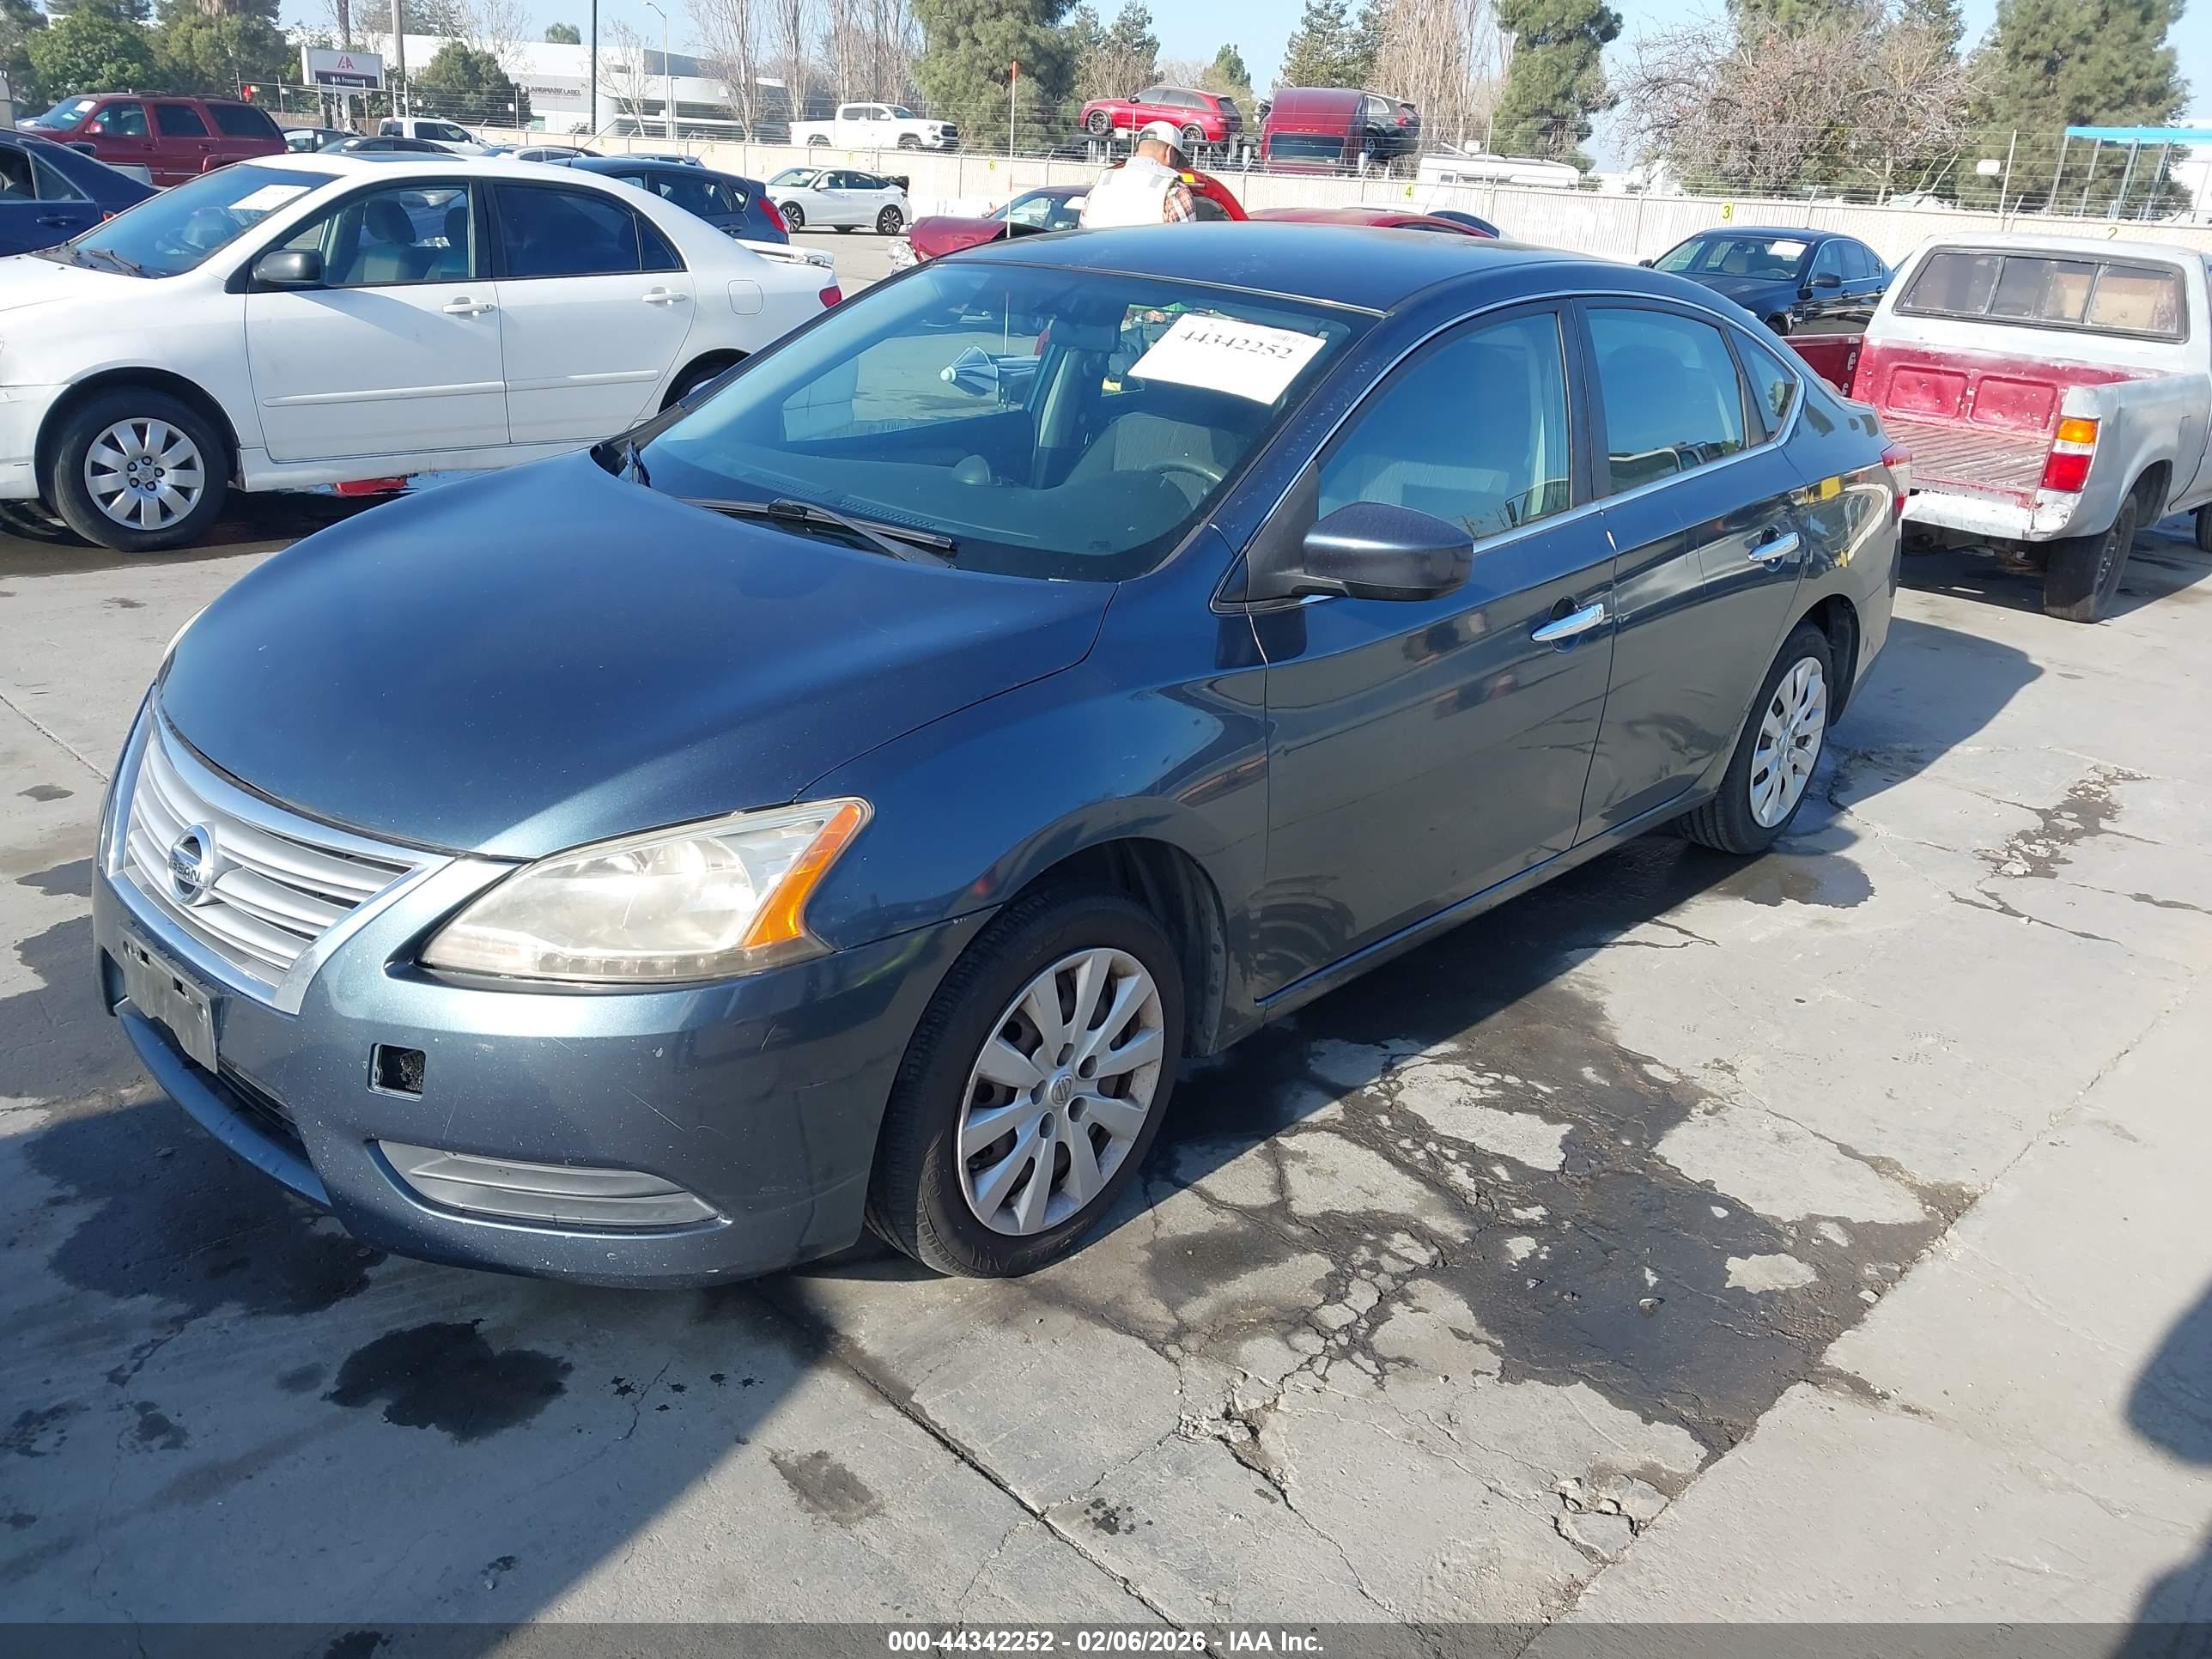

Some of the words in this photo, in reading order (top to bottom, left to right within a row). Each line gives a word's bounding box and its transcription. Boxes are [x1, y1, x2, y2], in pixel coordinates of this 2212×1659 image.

[989, 160, 994, 171] 6
[1405, 185, 1412, 198] 4
[1723, 205, 1730, 219] 3
[2108, 227, 2118, 240] 2
[1180, 331, 1293, 359] 44342252
